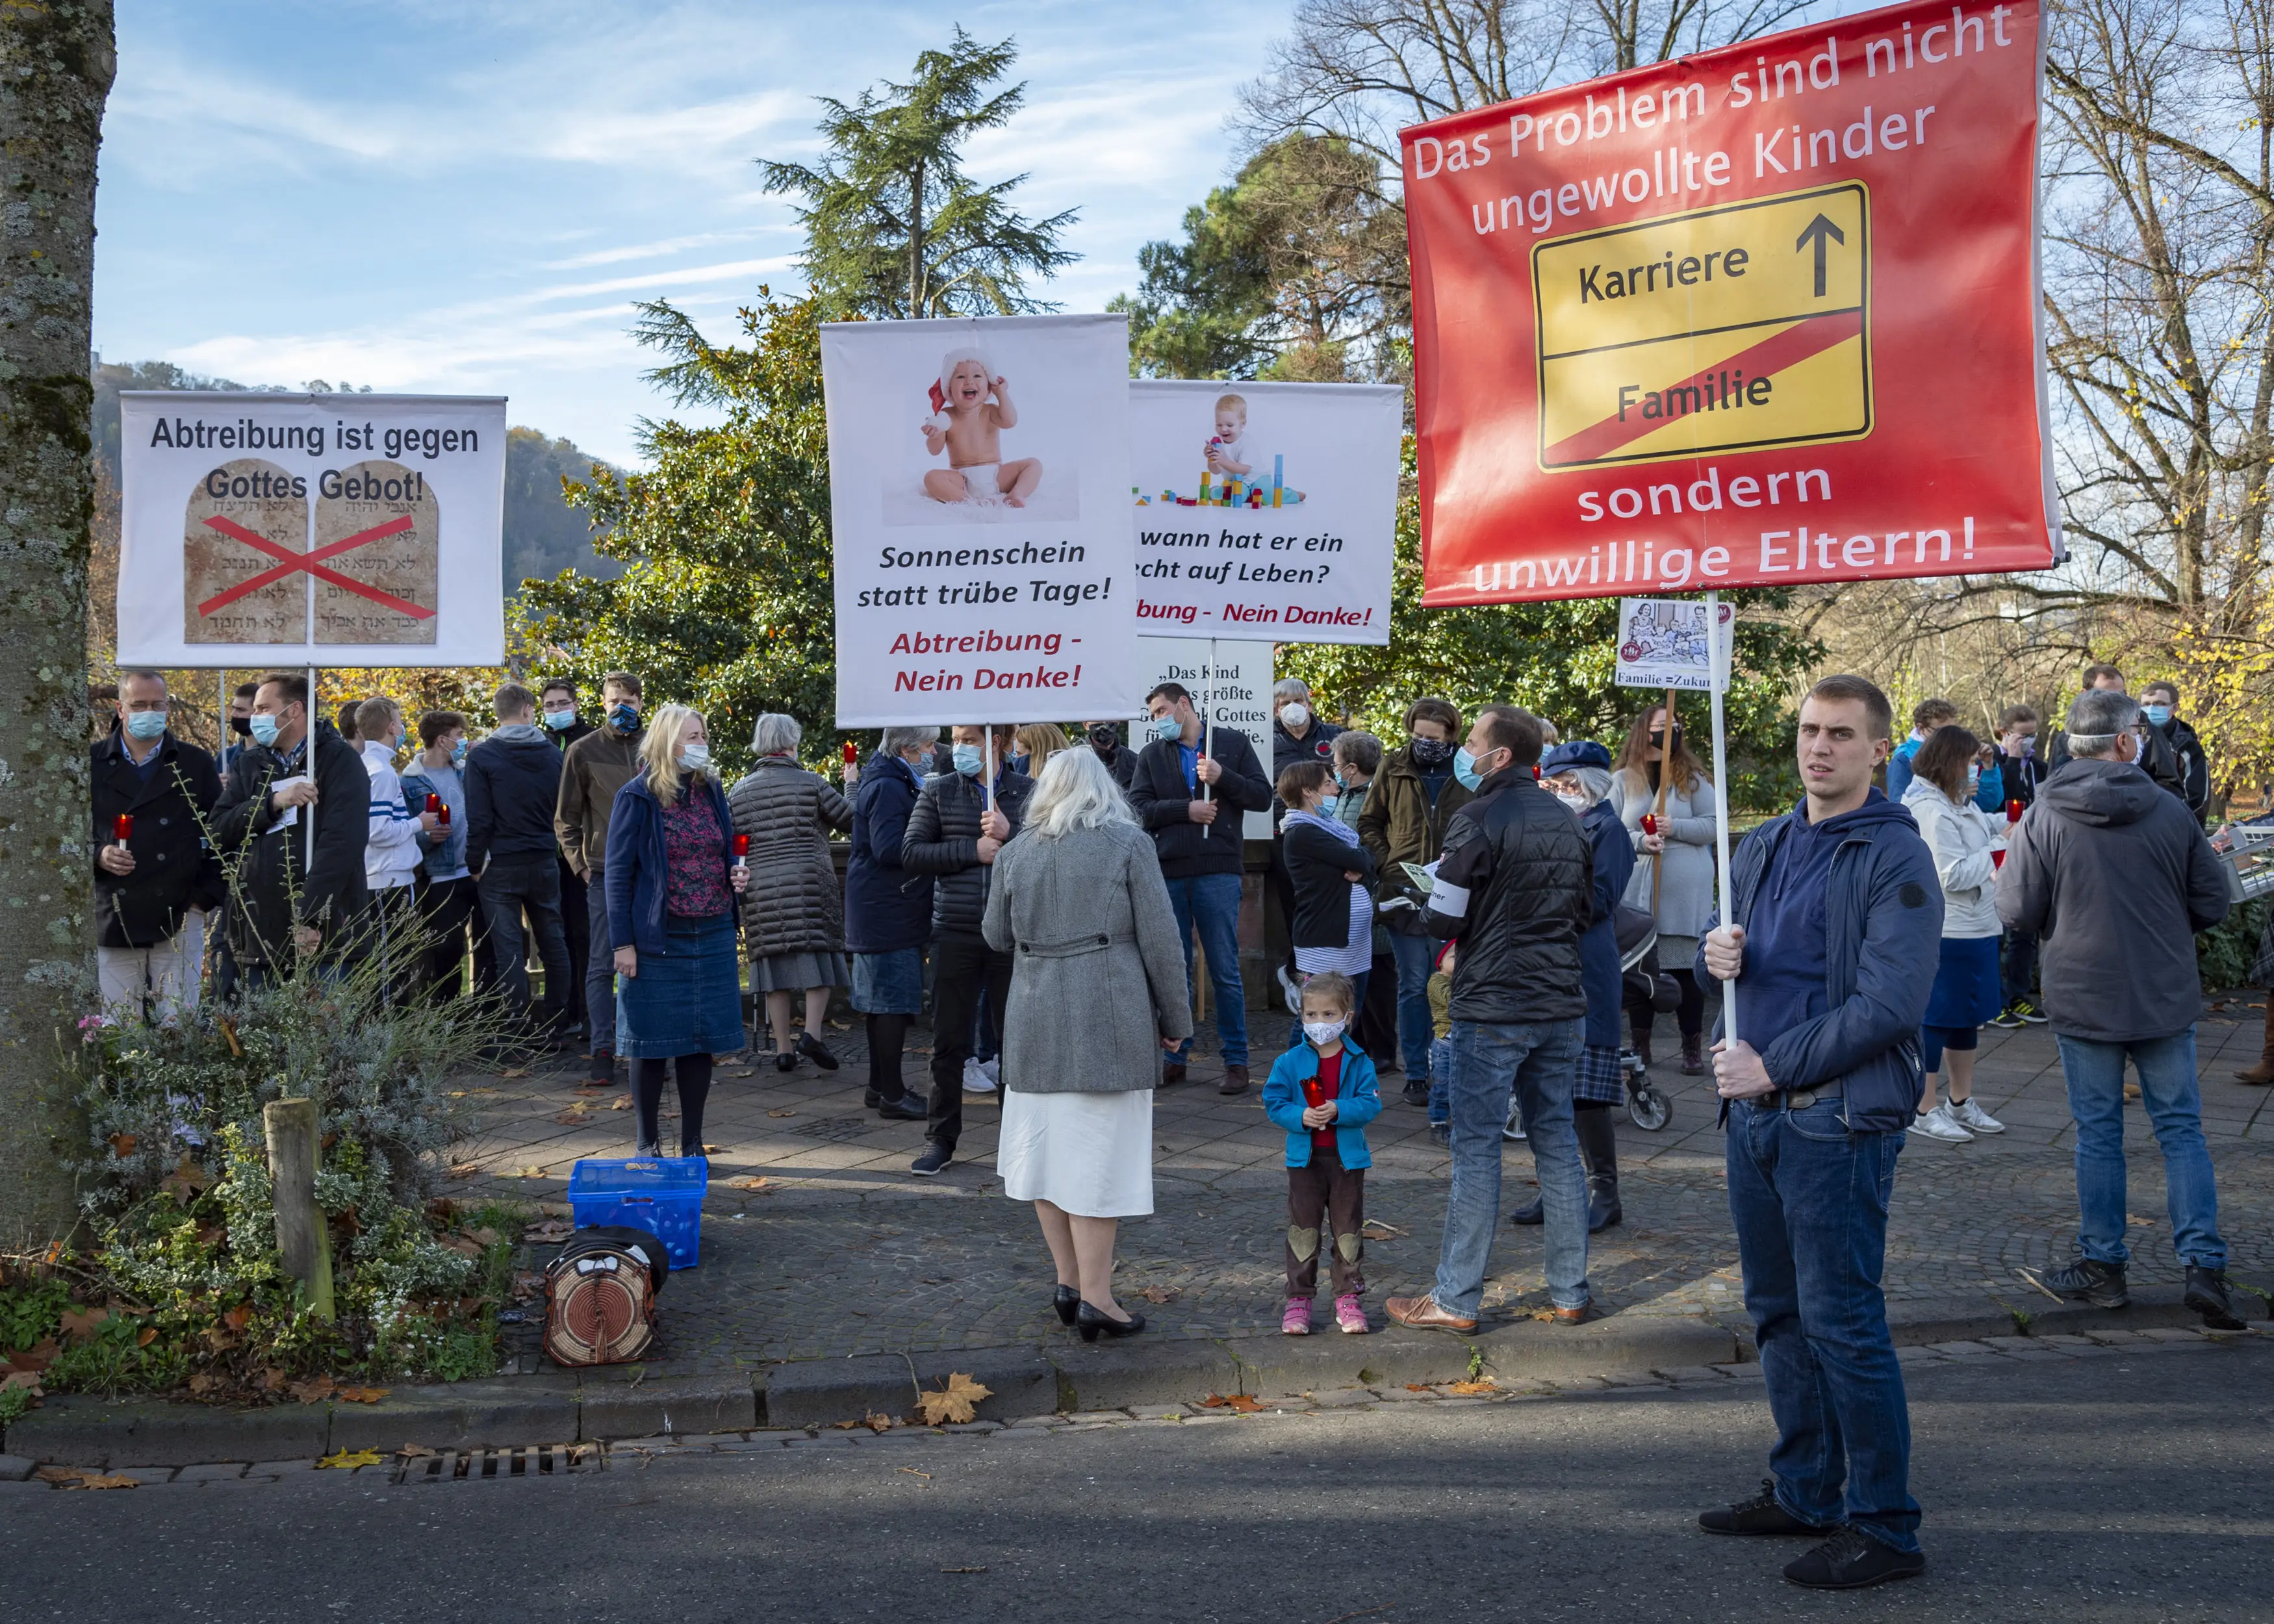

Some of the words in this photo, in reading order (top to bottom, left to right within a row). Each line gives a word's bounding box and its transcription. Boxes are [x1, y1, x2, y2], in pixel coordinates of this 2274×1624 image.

[1414, 132, 1491, 180] Das
[1510, 81, 1706, 160] Problem
[1730, 37, 1839, 108] sind
[1866, 4, 2012, 78] nicht
[1472, 149, 1730, 235] ungewollte
[1754, 105, 1935, 179] Kinder
[1579, 247, 1748, 302] Karriere
[1618, 370, 1772, 422] Familie
[151, 417, 324, 457] Abtreibung
[337, 420, 374, 451] ist
[385, 428, 478, 459] gegen
[206, 468, 307, 500] Gottes
[319, 469, 423, 501] Gebot!
[1578, 468, 1832, 522] sondern
[879, 540, 1084, 568] Sonnenschein
[1141, 531, 1210, 547] wann
[1218, 528, 1263, 550] hat
[1270, 536, 1297, 550] er
[1305, 532, 1343, 552] ein
[1474, 540, 1730, 590] unwillige
[1758, 516, 1974, 573] Eltern!
[1188, 561, 1233, 585] auf
[1238, 563, 1330, 584] Leben?
[857, 585, 928, 607] statt
[938, 580, 1018, 605] trübe
[1029, 576, 1111, 606] Tage!
[1135, 599, 1197, 624] bung
[1222, 603, 1278, 622] Nein
[1283, 605, 1372, 625] Danke!
[889, 629, 1062, 655] Abtreibung
[894, 669, 963, 692] Nein
[973, 664, 1081, 690] Danke!
[1158, 665, 1196, 681] „Das
[1201, 665, 1240, 679] Kind
[1617, 672, 1662, 685] Familie
[1203, 685, 1253, 705] größte
[1216, 707, 1266, 722] Gottes
[1145, 728, 1160, 743] fü
[1431, 890, 1446, 901] ner
